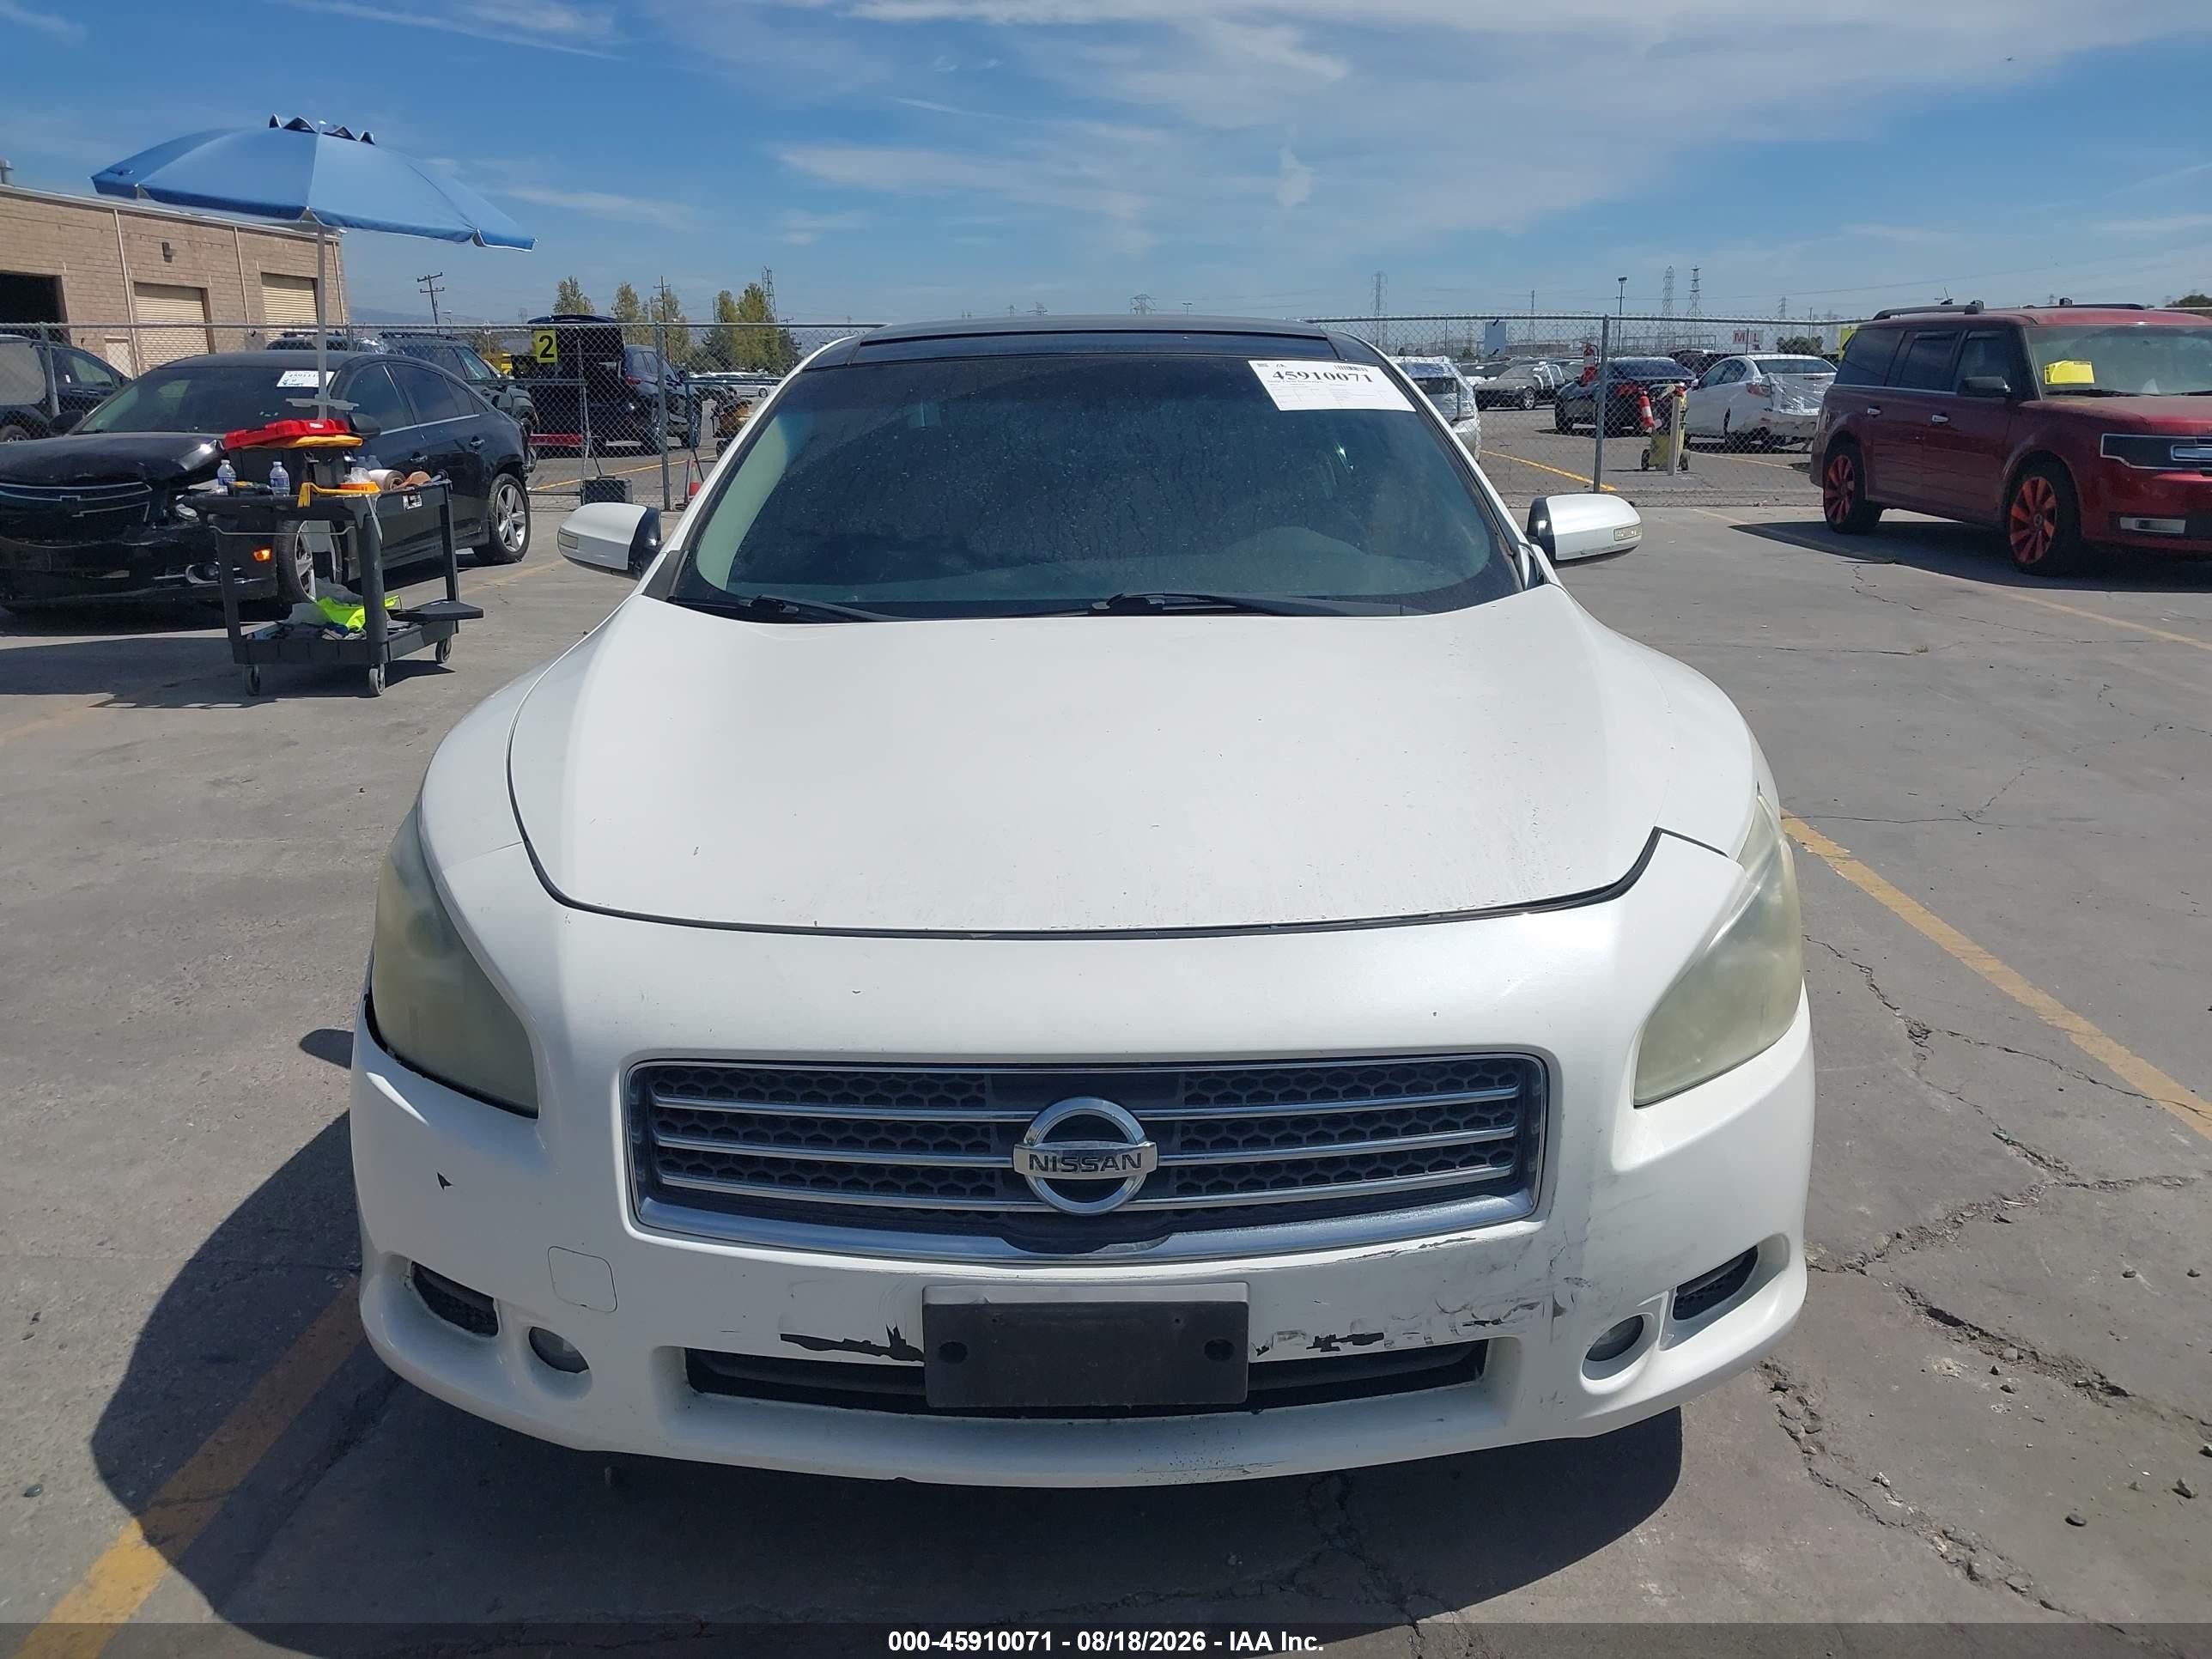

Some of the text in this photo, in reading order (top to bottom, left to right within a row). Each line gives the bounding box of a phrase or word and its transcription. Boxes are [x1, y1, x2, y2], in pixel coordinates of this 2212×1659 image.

[538, 335, 554, 358] 2
[1272, 370, 1373, 382] 45910071
[1028, 1152, 1141, 1172] NISSAN
